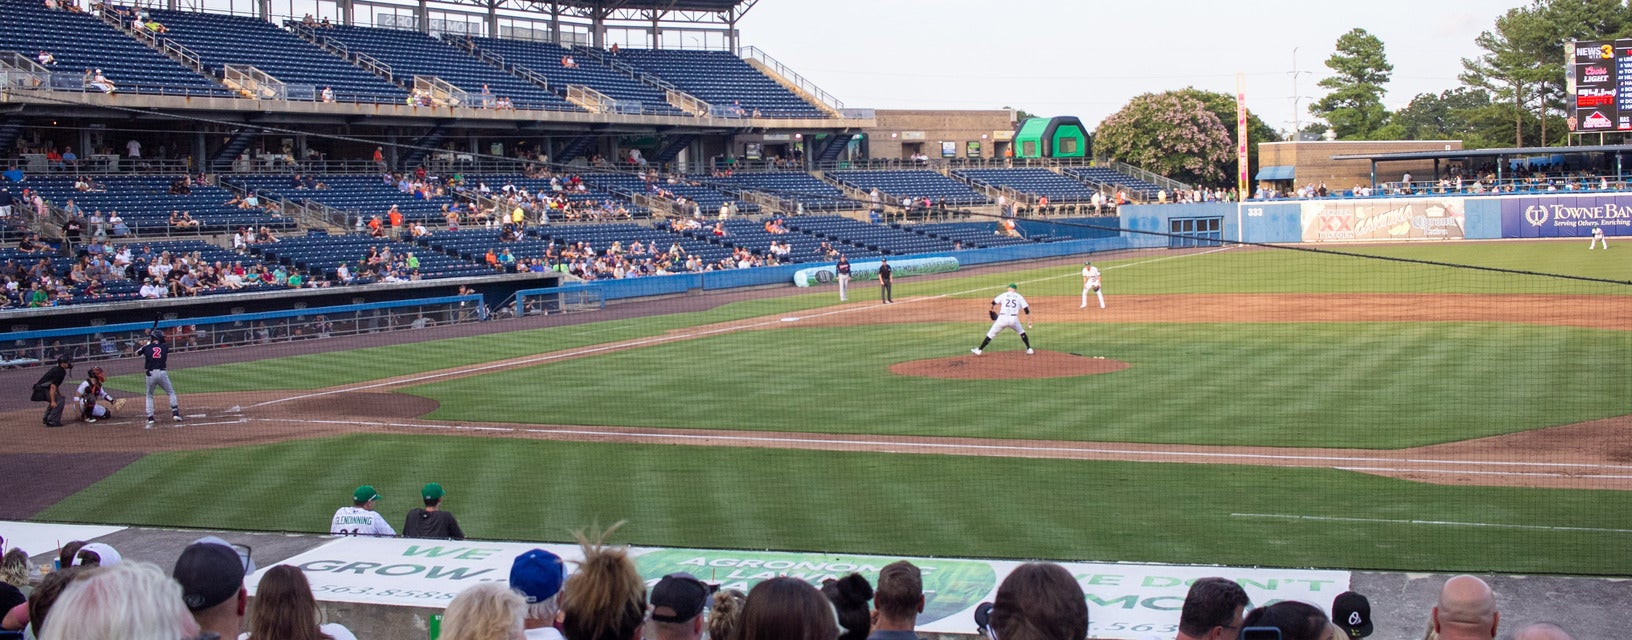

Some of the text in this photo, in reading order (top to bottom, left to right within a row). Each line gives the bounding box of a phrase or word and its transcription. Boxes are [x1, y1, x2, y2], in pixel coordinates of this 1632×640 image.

[1576, 47, 1601, 56] NEWS
[1600, 44, 1613, 59] 3
[1585, 65, 1607, 75] Coors
[1583, 75, 1609, 83] LIGHT
[1578, 96, 1614, 106] ESPN
[1247, 207, 1263, 217] 333
[1320, 216, 1352, 231] XX
[1412, 215, 1456, 229] Corona
[1554, 220, 1577, 228] Serving
[1601, 219, 1631, 227] Enriching
[1005, 298, 1017, 309] 25
[152, 346, 162, 359] 2
[335, 515, 373, 526] GLENDINNING
[402, 545, 504, 560] WE
